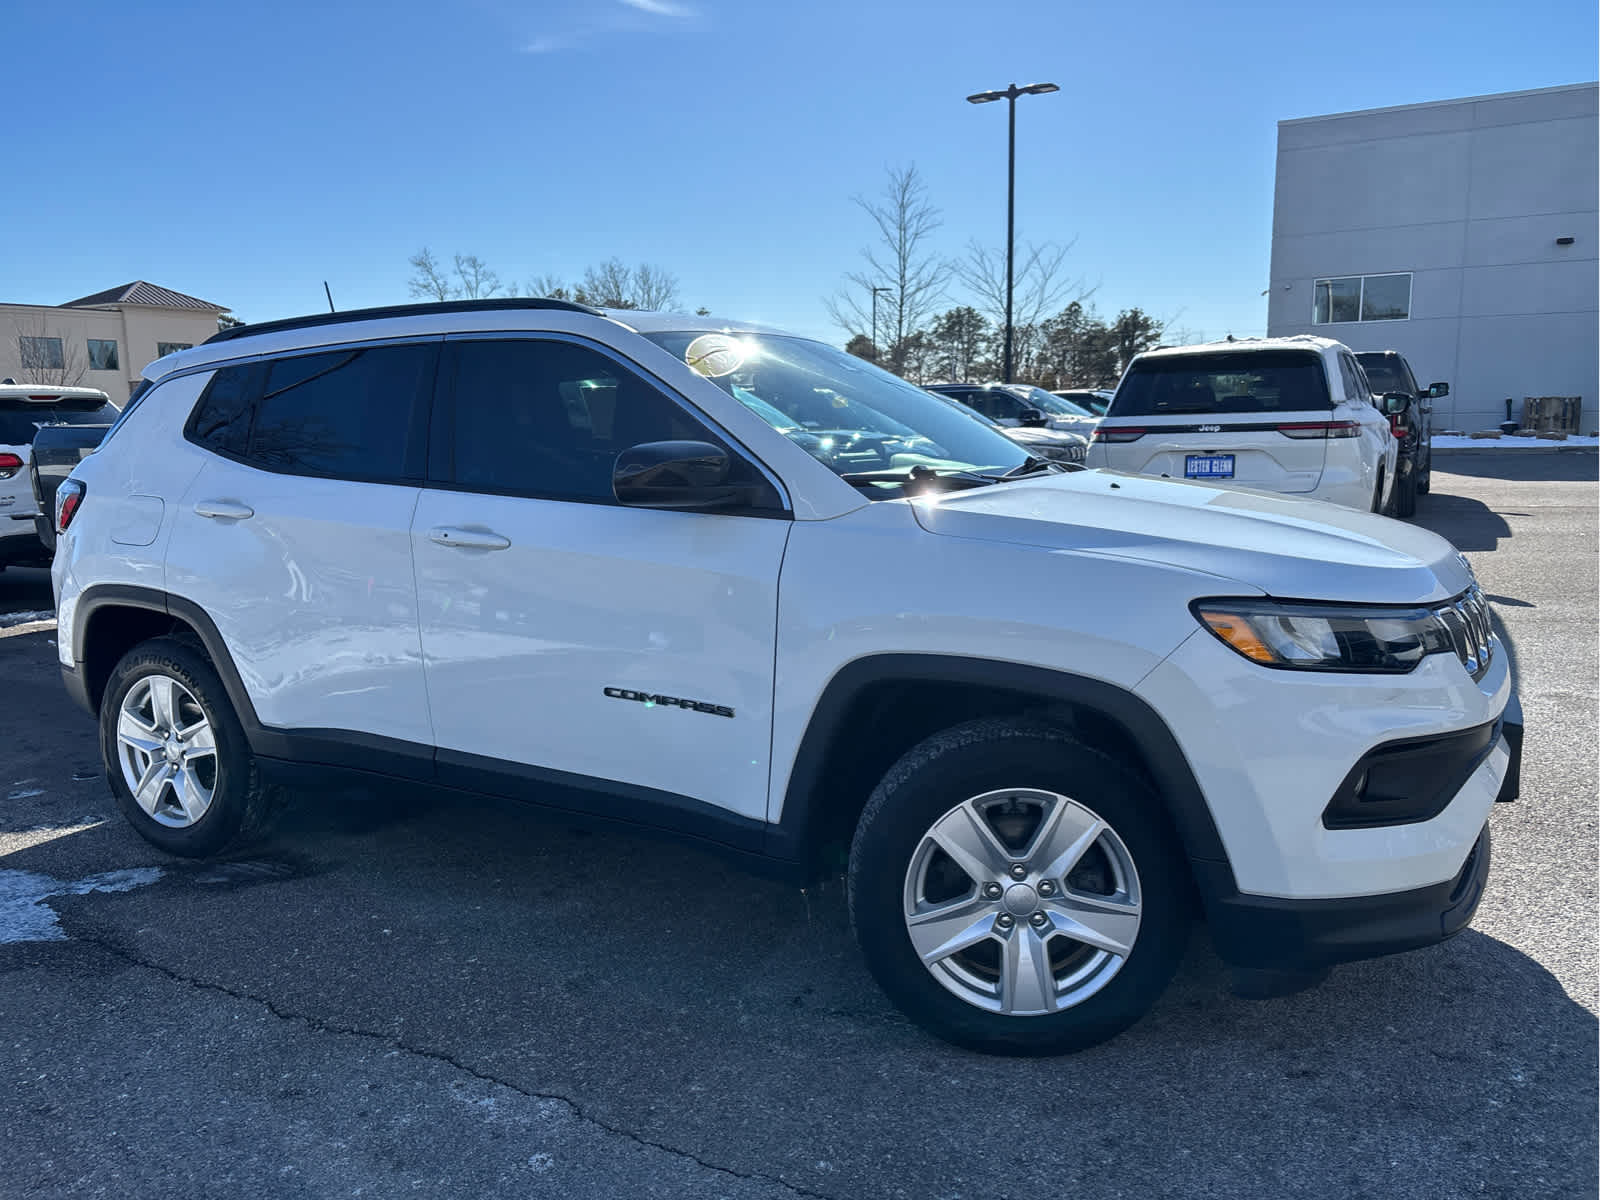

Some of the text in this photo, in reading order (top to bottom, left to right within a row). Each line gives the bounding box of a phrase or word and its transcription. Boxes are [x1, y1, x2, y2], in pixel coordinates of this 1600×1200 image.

[1199, 424, 1221, 432] Jeep
[1187, 459, 1232, 473] LESTER GLENN
[603, 686, 735, 718] COMPASS
